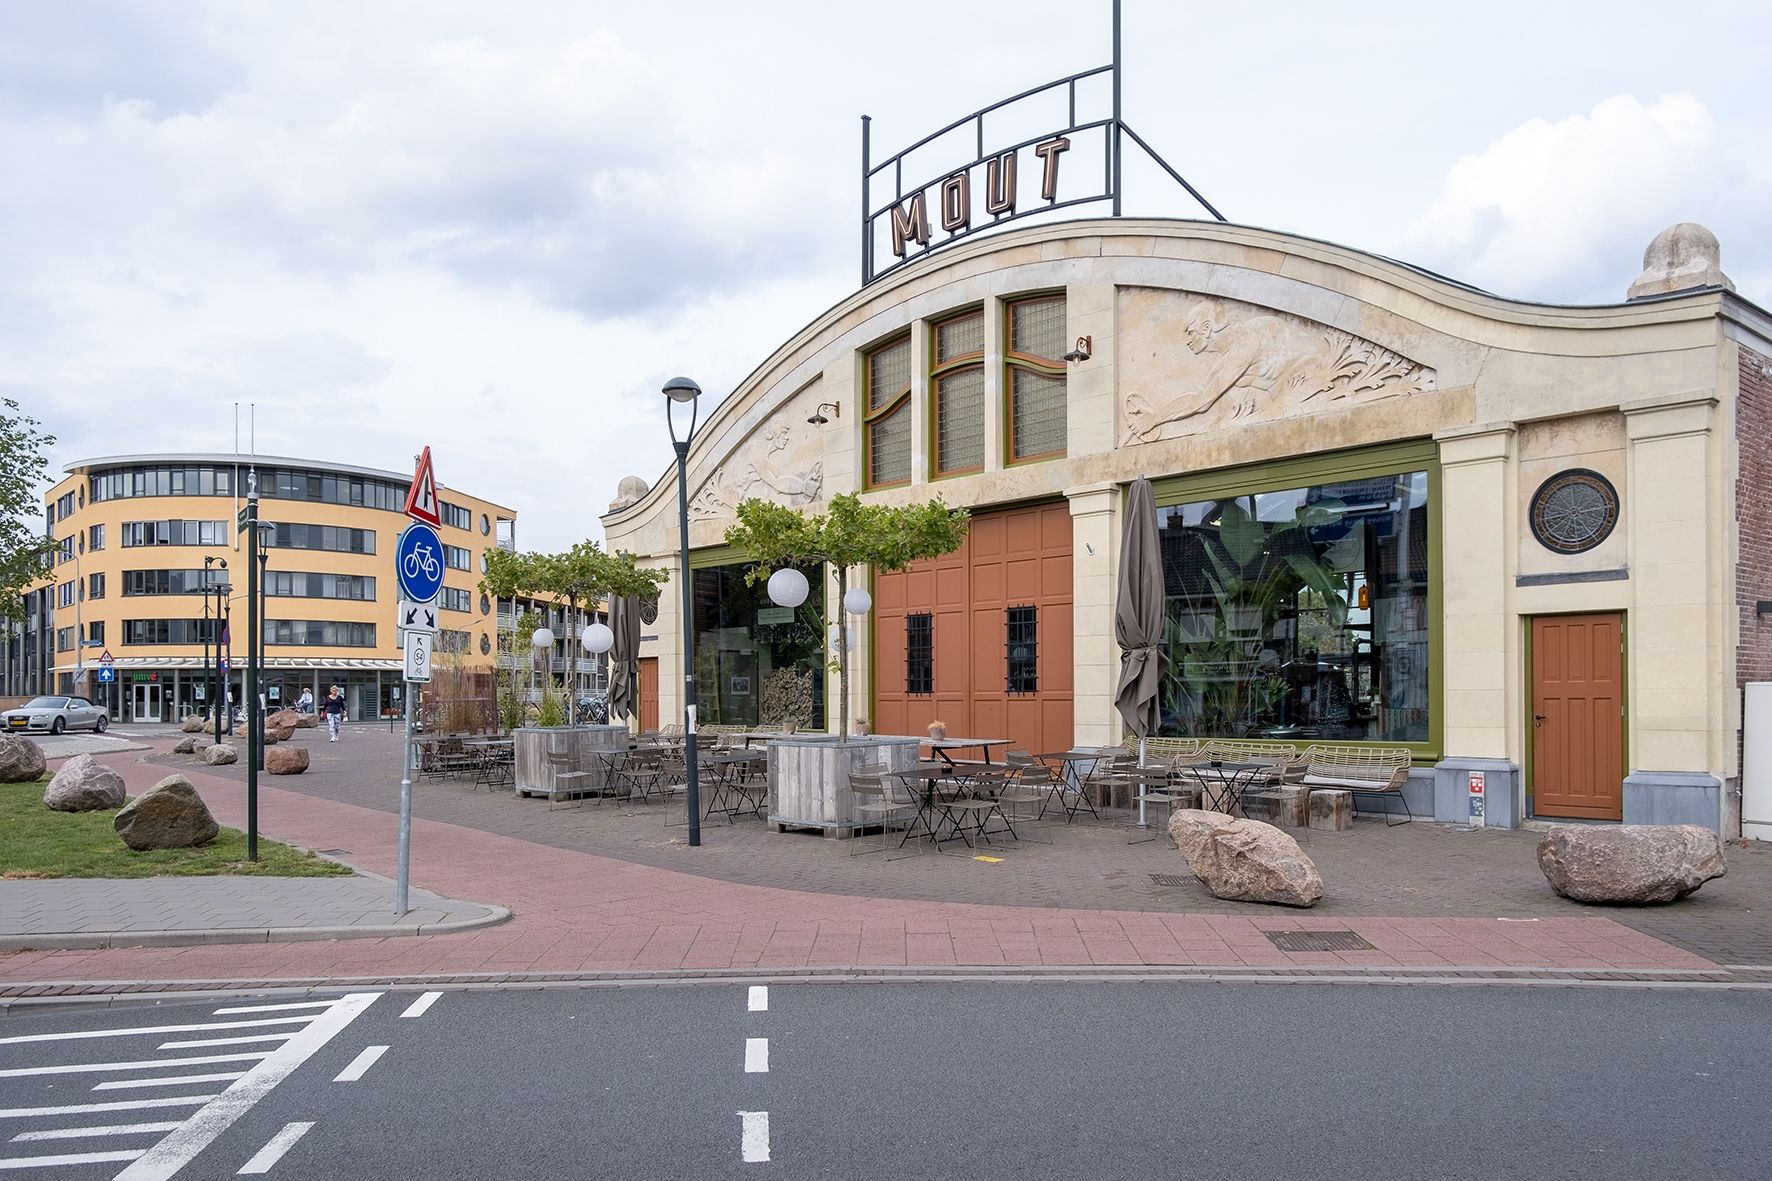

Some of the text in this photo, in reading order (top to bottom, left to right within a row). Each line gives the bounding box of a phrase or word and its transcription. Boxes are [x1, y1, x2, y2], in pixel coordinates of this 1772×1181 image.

[890, 137, 1071, 257] MOUT
[415, 652, 423, 661] 54
[133, 671, 158, 681] univé
